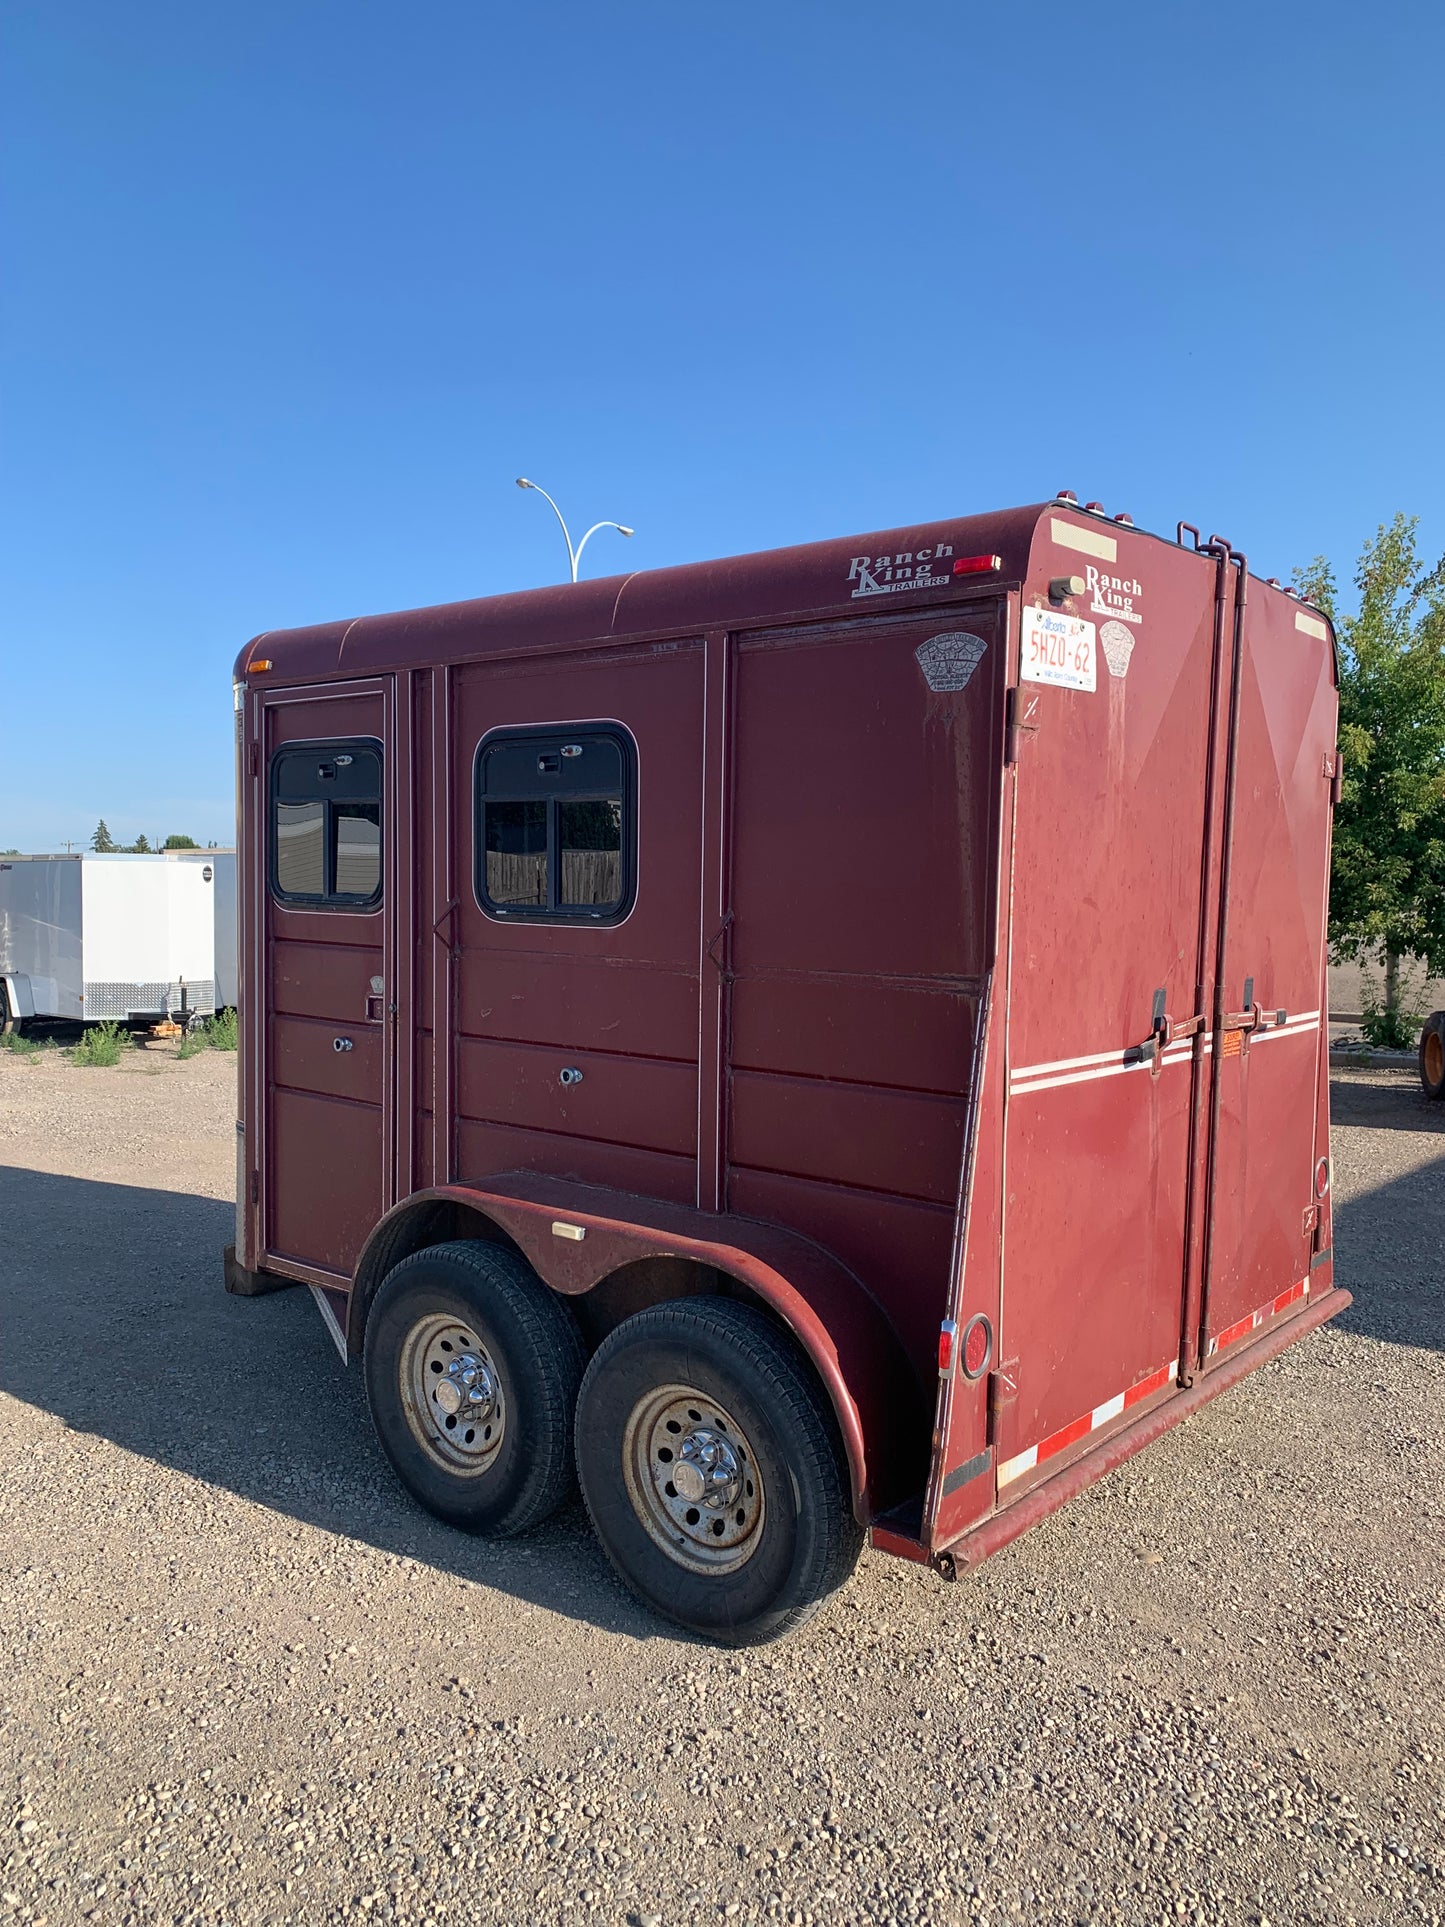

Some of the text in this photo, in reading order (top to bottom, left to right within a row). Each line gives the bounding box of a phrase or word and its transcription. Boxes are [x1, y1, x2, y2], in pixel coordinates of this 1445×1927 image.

[845, 543, 953, 580] Ranch
[858, 564, 933, 593] King
[888, 576, 946, 592] TRAILERS
[1085, 564, 1142, 597] Ranch
[1093, 584, 1133, 612] King
